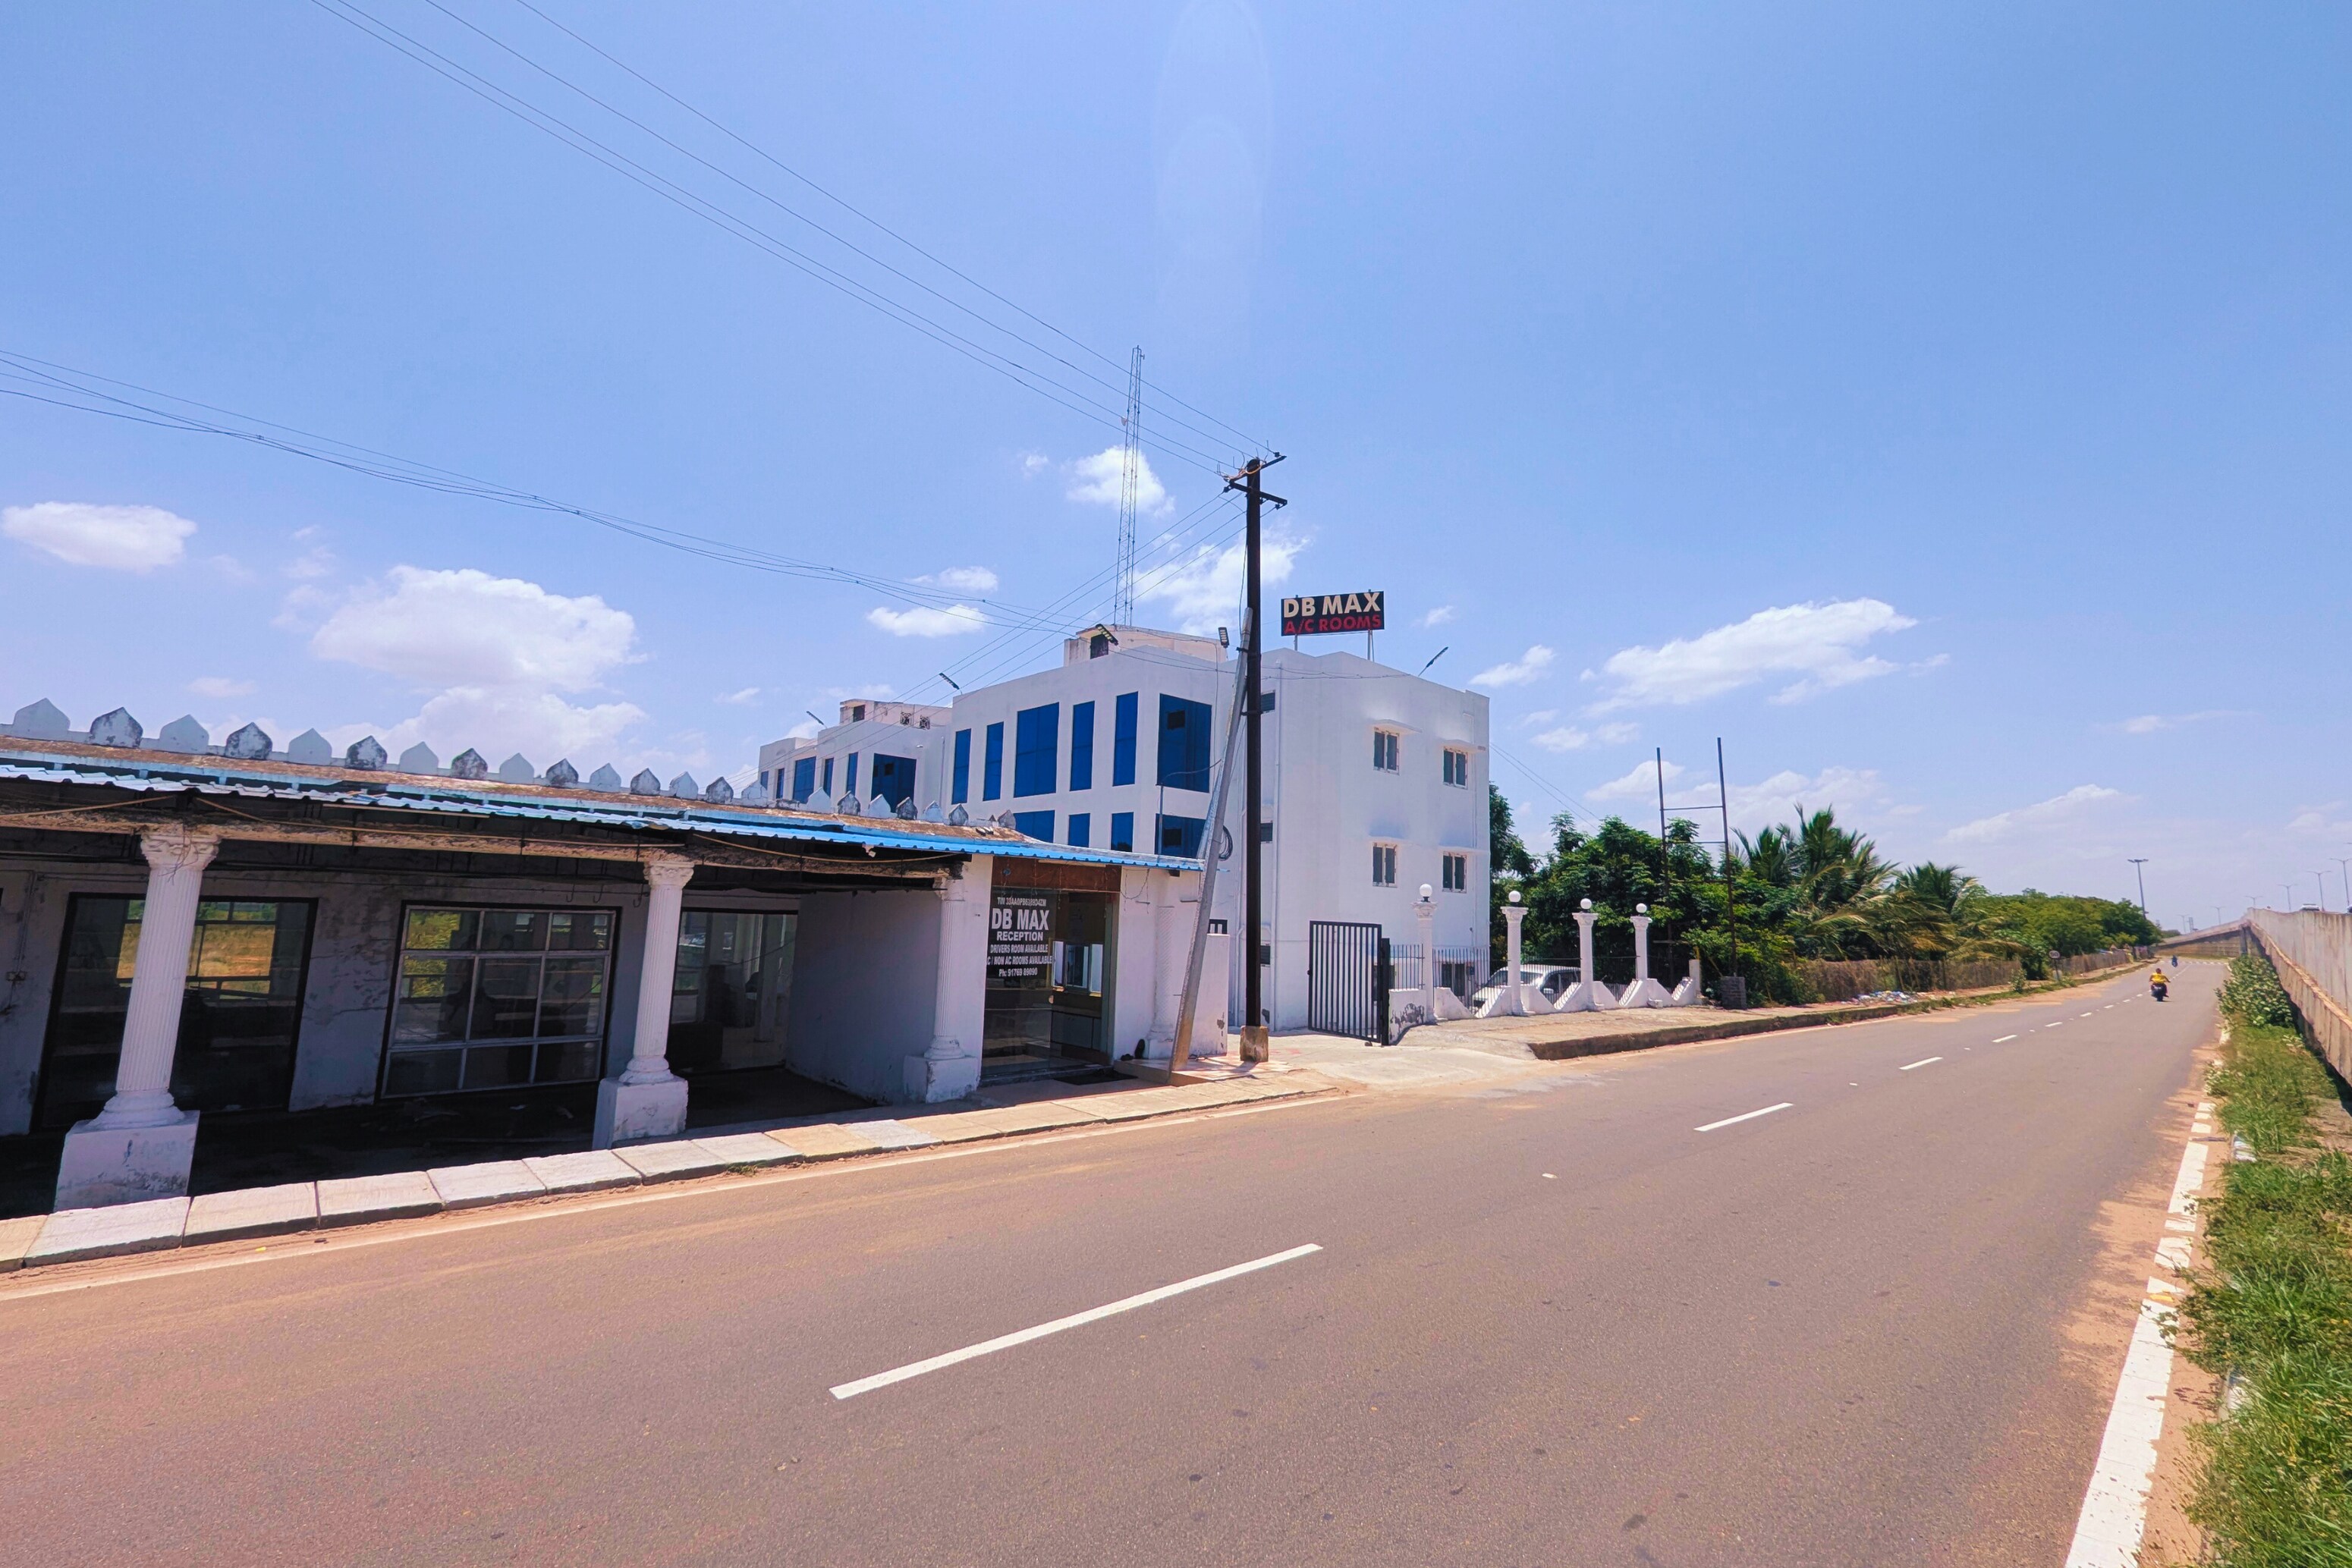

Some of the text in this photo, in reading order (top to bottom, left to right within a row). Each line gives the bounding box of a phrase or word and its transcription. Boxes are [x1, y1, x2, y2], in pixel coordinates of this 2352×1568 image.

[1283, 592, 1381, 618] DB MAX
[1284, 614, 1382, 635] A/C ROOMS
[992, 908, 1049, 931] DB MAX
[996, 931, 1044, 941] RECEPTION
[990, 944, 1049, 954] DRIVERS ROOM AVAILABLE
[993, 956, 1005, 965] NON
[1005, 956, 1012, 965] AC
[1011, 956, 1029, 965] ROOMS
[1028, 956, 1052, 965] AVAILABLE
